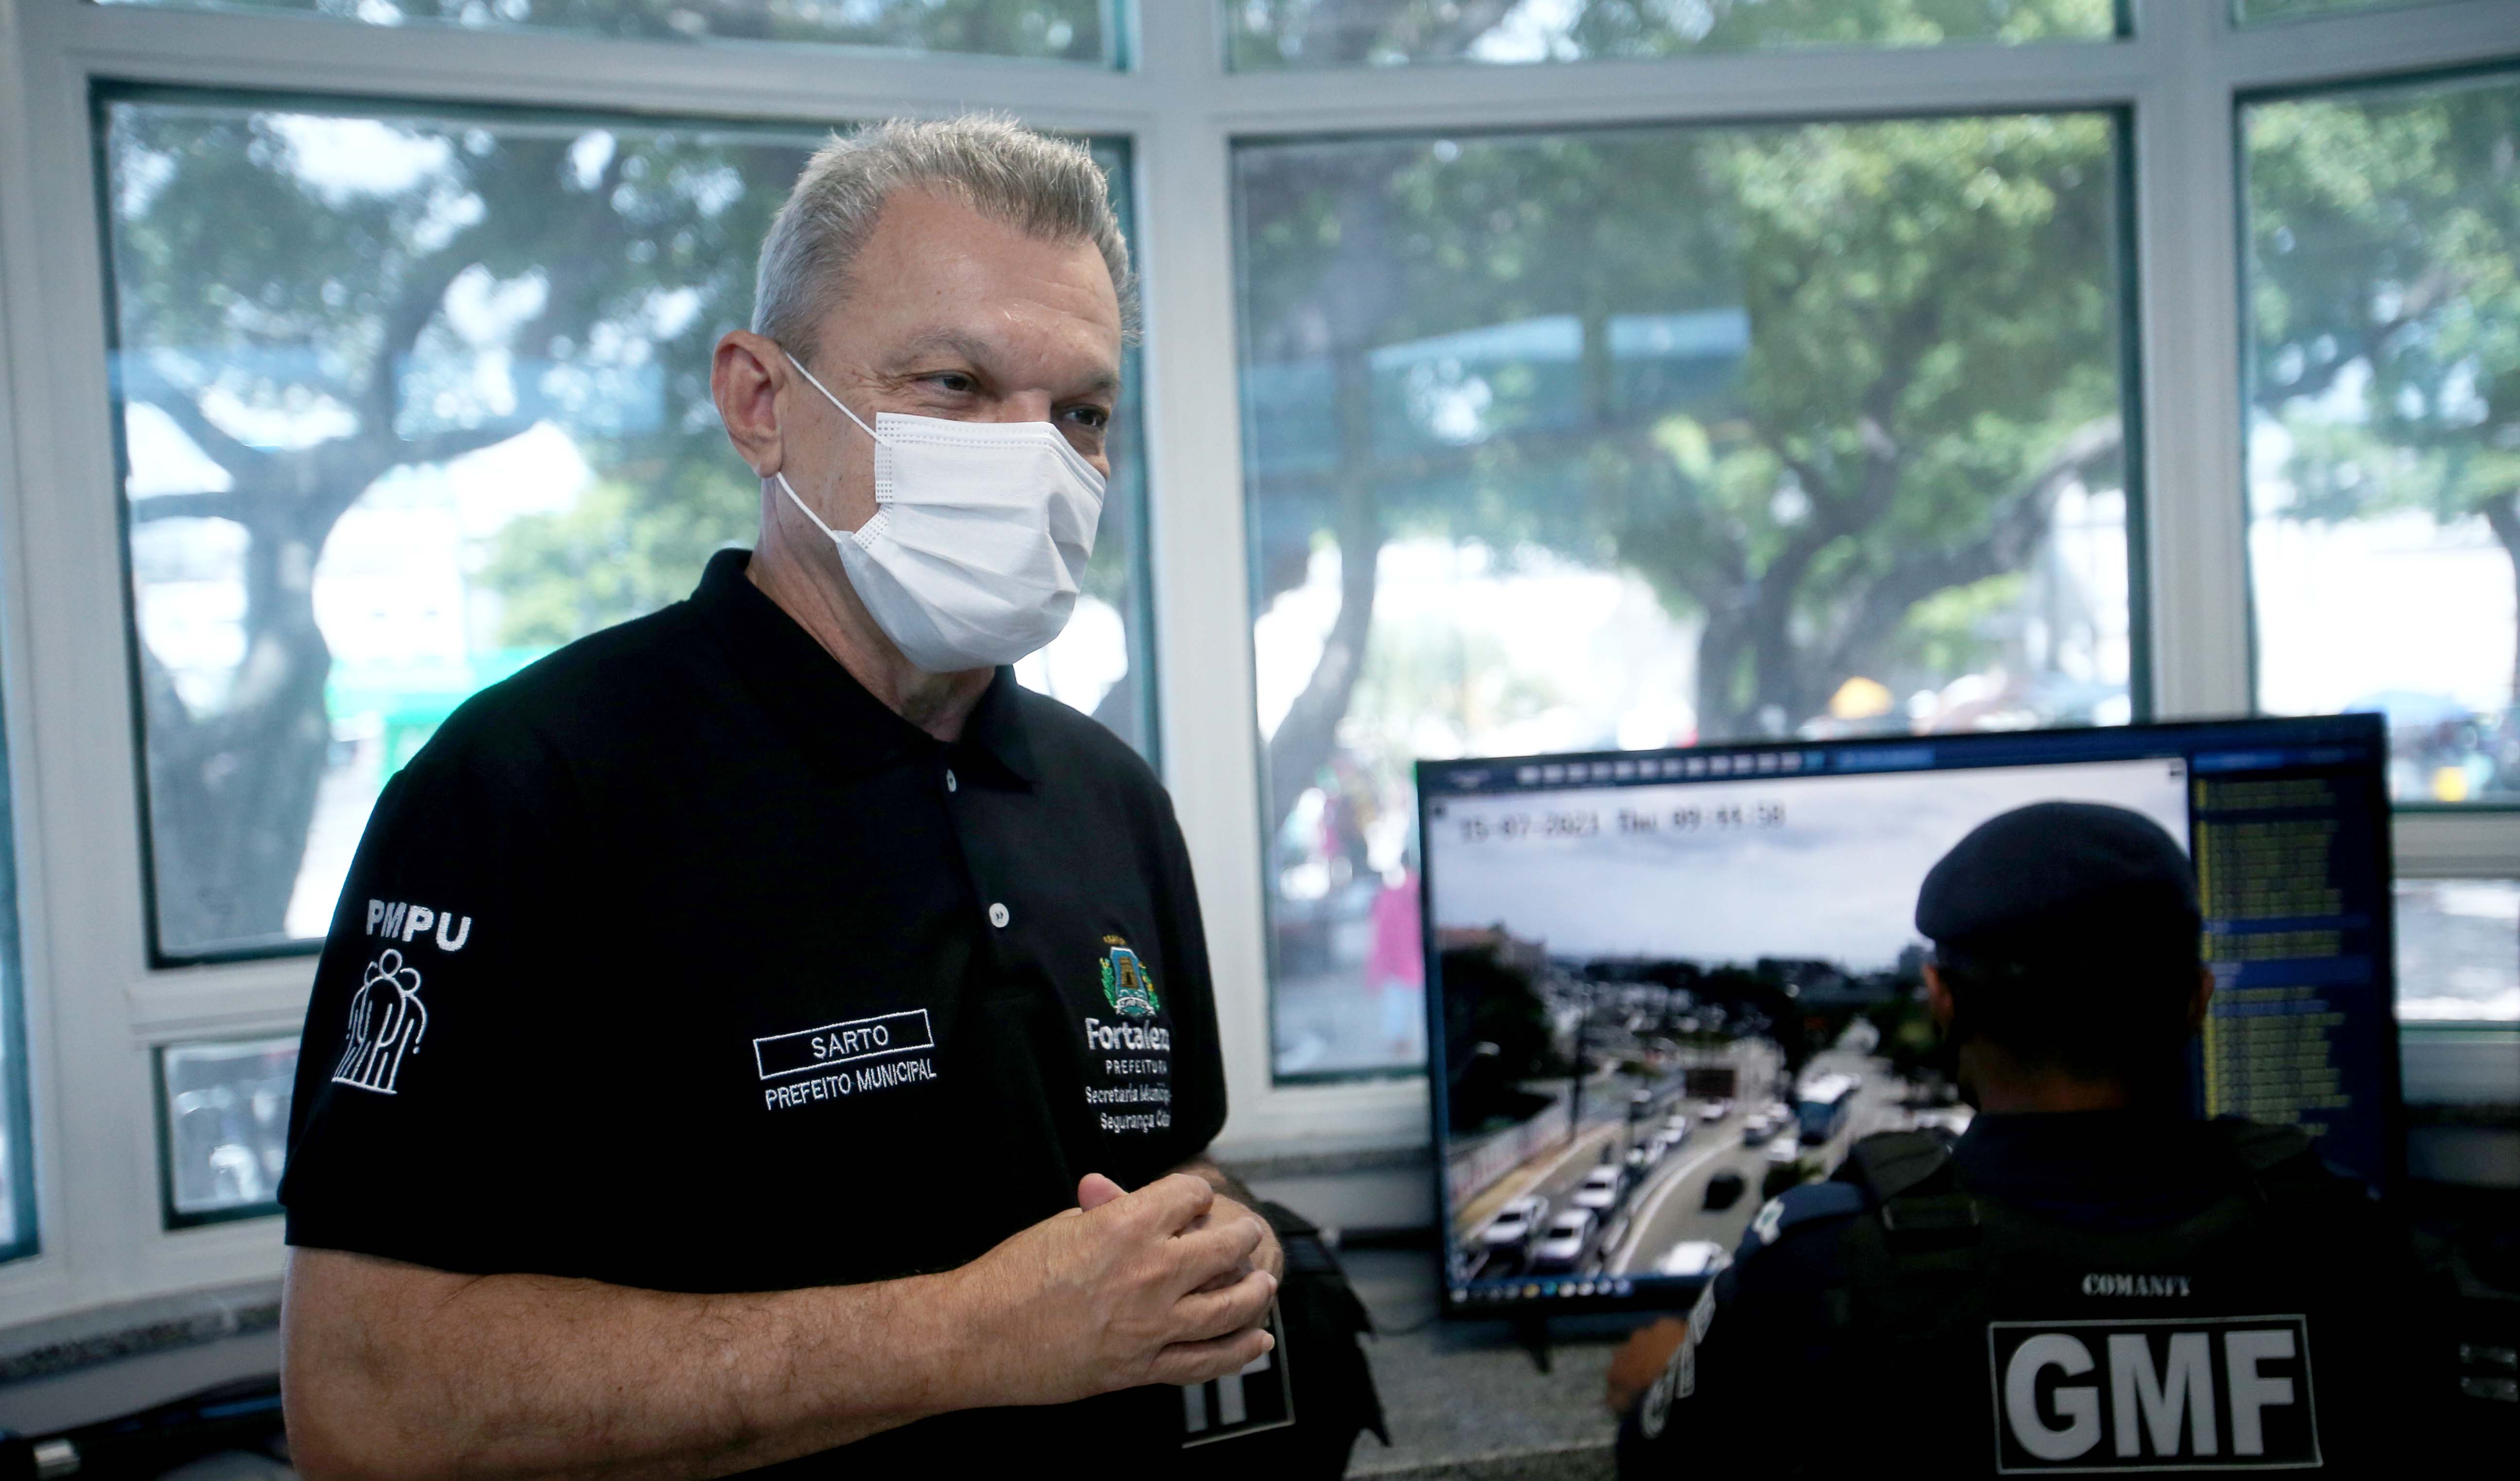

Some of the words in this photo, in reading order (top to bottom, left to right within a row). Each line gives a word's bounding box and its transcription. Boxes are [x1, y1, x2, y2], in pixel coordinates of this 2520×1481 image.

[367, 899, 472, 952] PMPU
[811, 1024, 889, 1059] SARTO
[765, 1073, 853, 1111] PREFEITO
[856, 1058, 937, 1093] MUNICIPAL
[1085, 1082, 1139, 1104] Secretaria
[1100, 1112, 1155, 1134] Segurança
[2005, 1329, 2295, 1460] GMF
